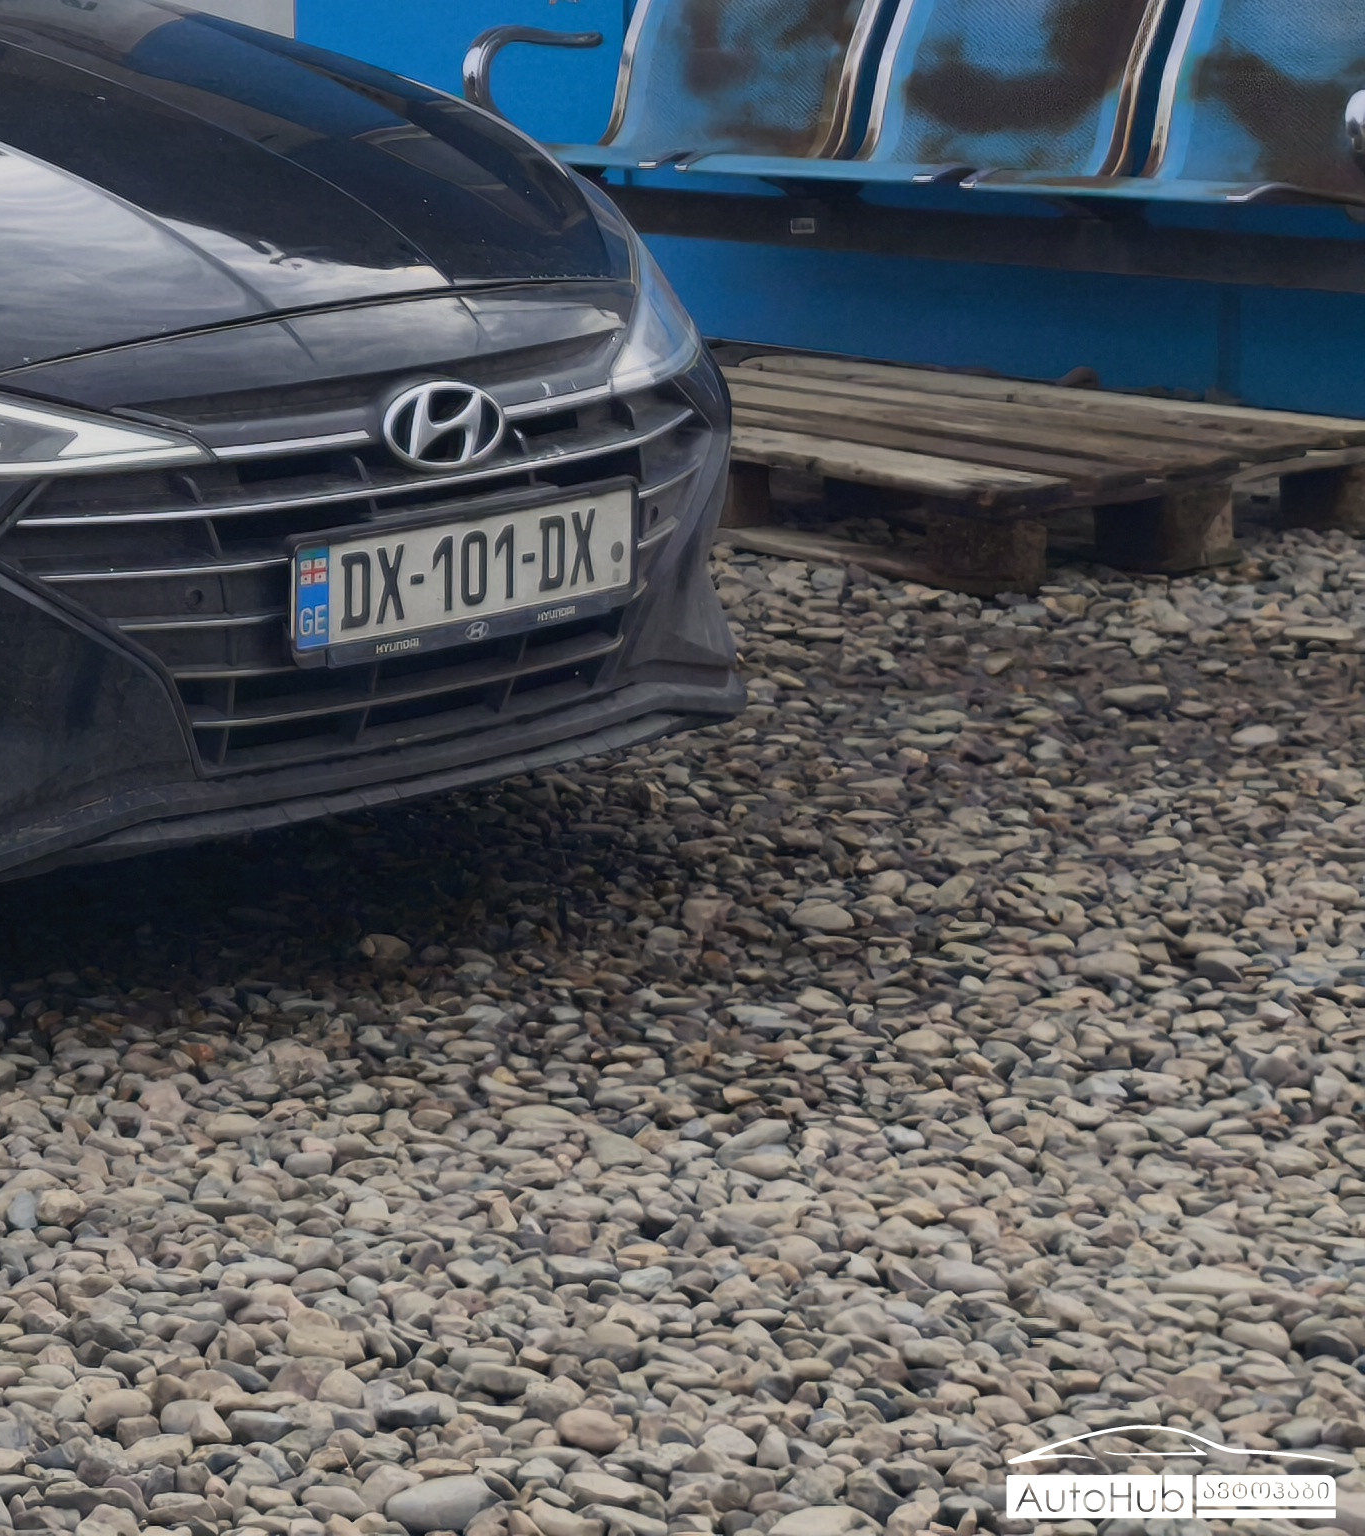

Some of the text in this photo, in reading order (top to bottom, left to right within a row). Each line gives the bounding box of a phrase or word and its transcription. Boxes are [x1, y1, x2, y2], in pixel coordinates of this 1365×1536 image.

[340, 507, 596, 632] DX-101-DX
[298, 603, 326, 636] GE
[536, 605, 576, 622] HYUNDAI
[375, 637, 420, 655] HYUNDAI
